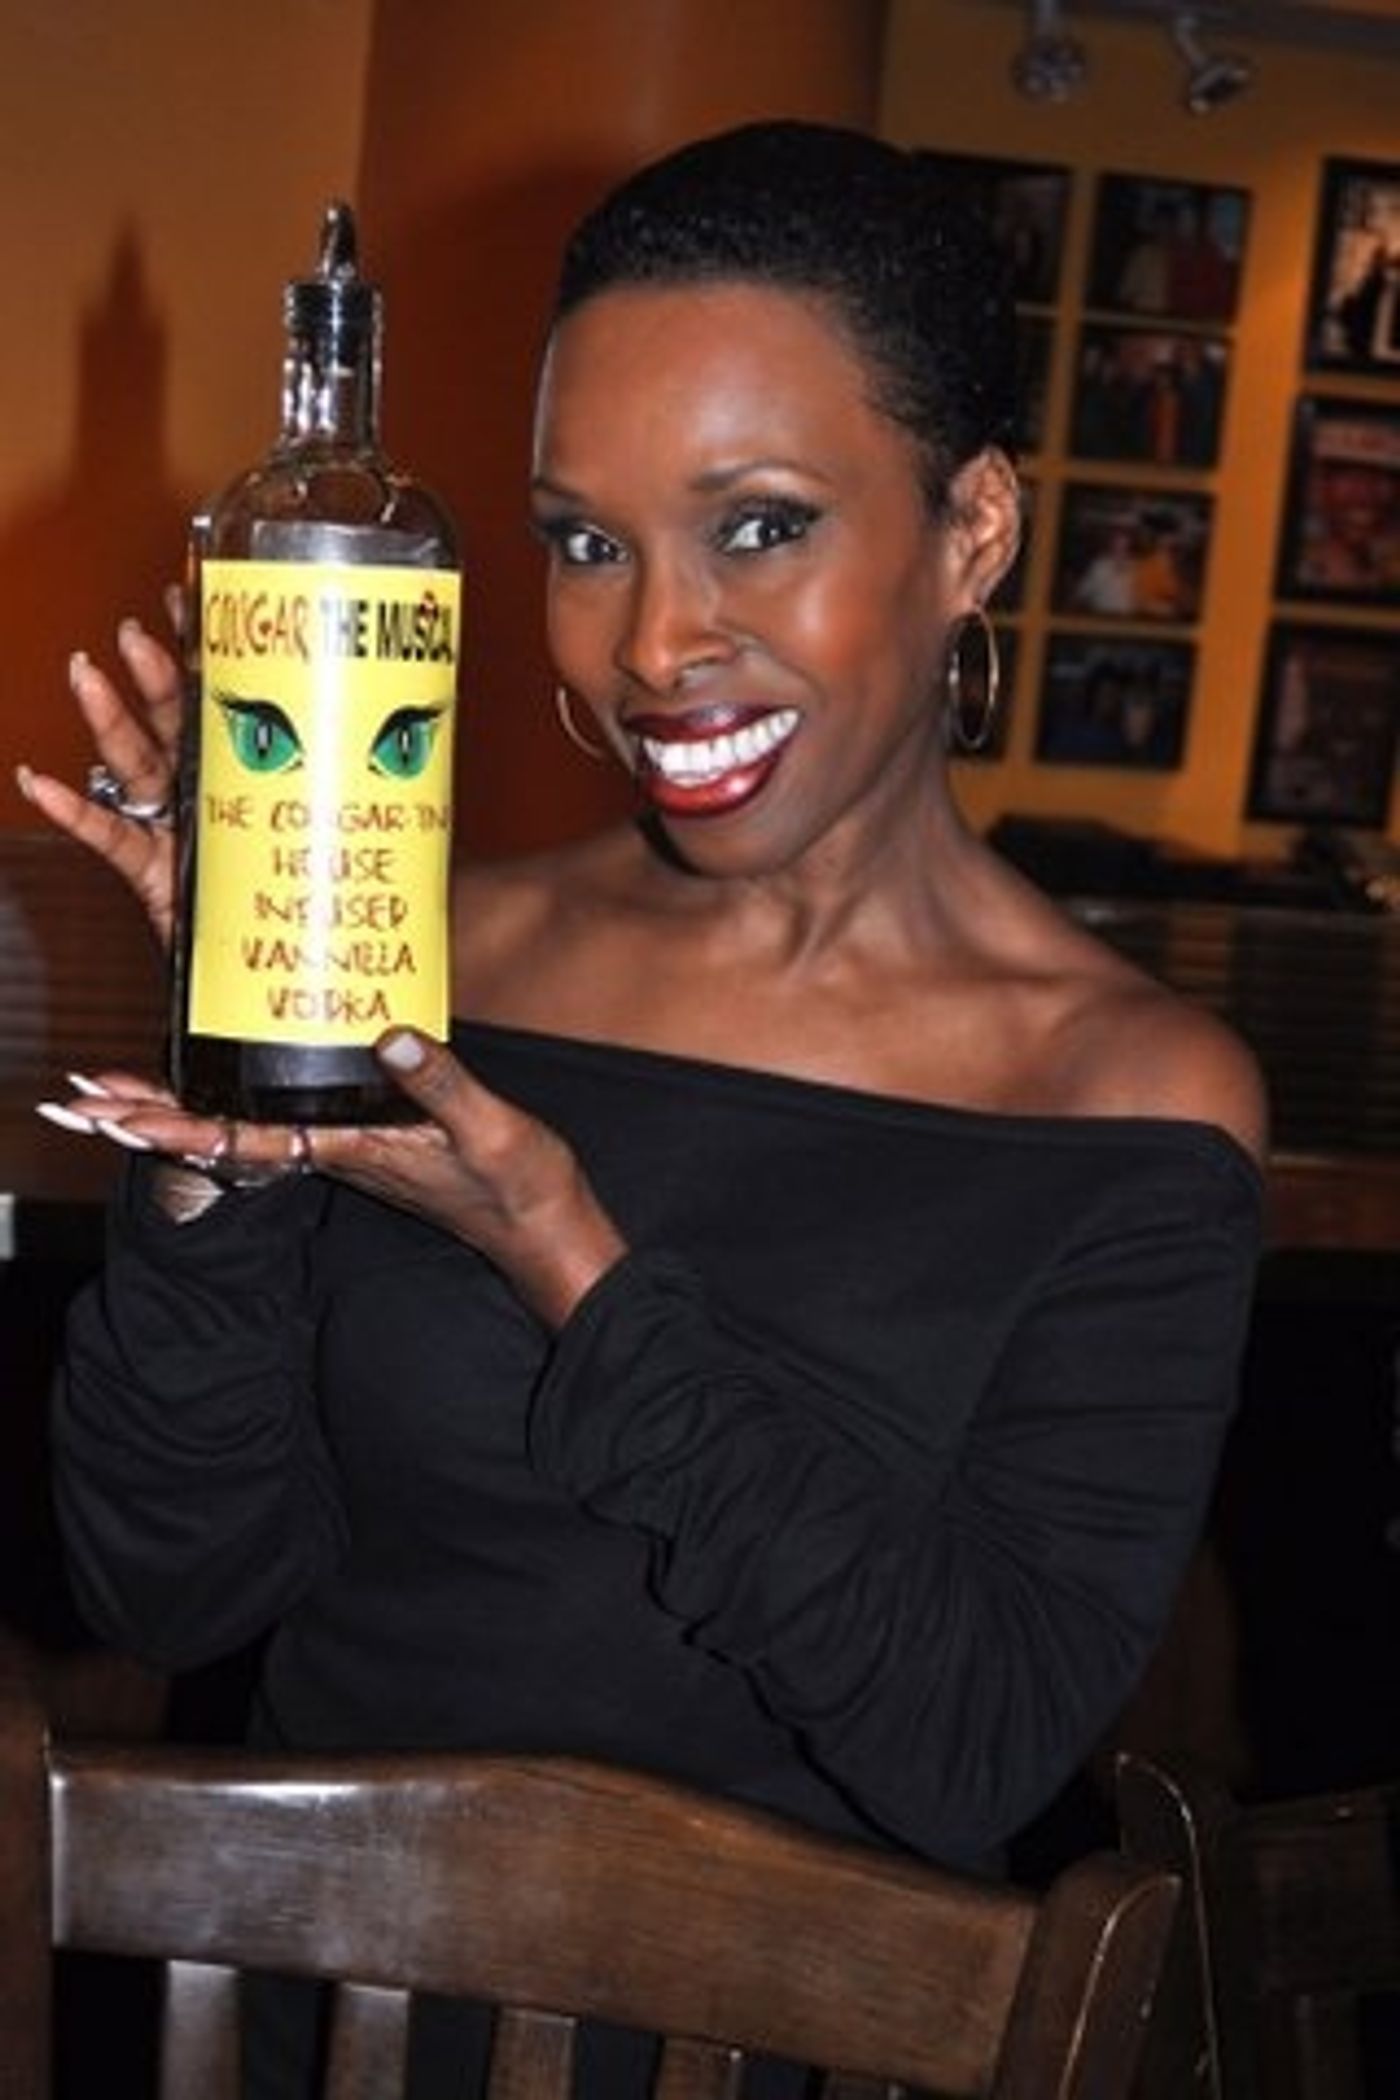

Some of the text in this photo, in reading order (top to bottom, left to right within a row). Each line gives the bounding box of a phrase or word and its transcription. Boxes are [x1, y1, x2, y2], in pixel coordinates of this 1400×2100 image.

[320, 598, 368, 658] THE
[206, 796, 252, 829] THE
[268, 987, 391, 1022] VODKA
